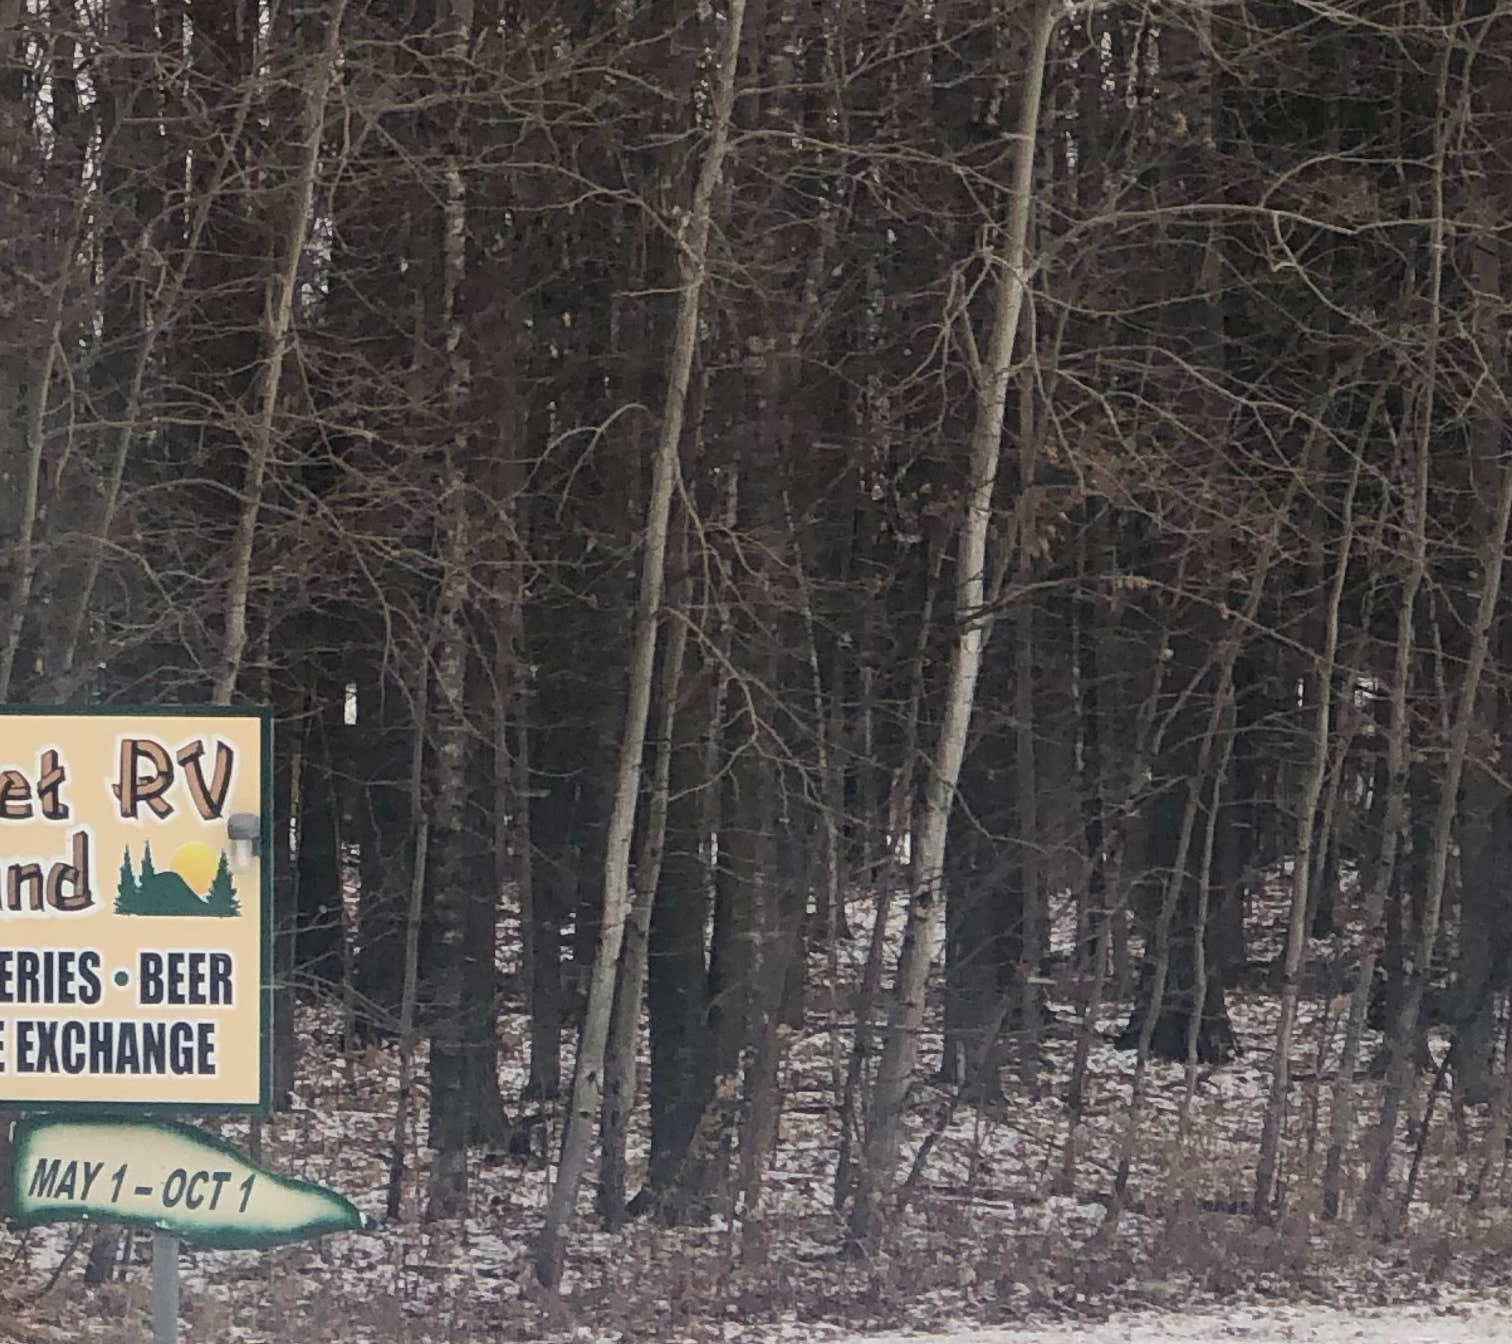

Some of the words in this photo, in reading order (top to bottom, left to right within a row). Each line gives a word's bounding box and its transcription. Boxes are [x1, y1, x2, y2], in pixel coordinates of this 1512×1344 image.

[112, 738, 235, 821] RV
[139, 952, 233, 1005] BEER
[16, 1020, 216, 1075] EXCHANGE
[28, 1157, 104, 1202] MAY
[111, 1164, 128, 1203] 1
[162, 1168, 232, 1211] OCT
[239, 1174, 256, 1213] 1
